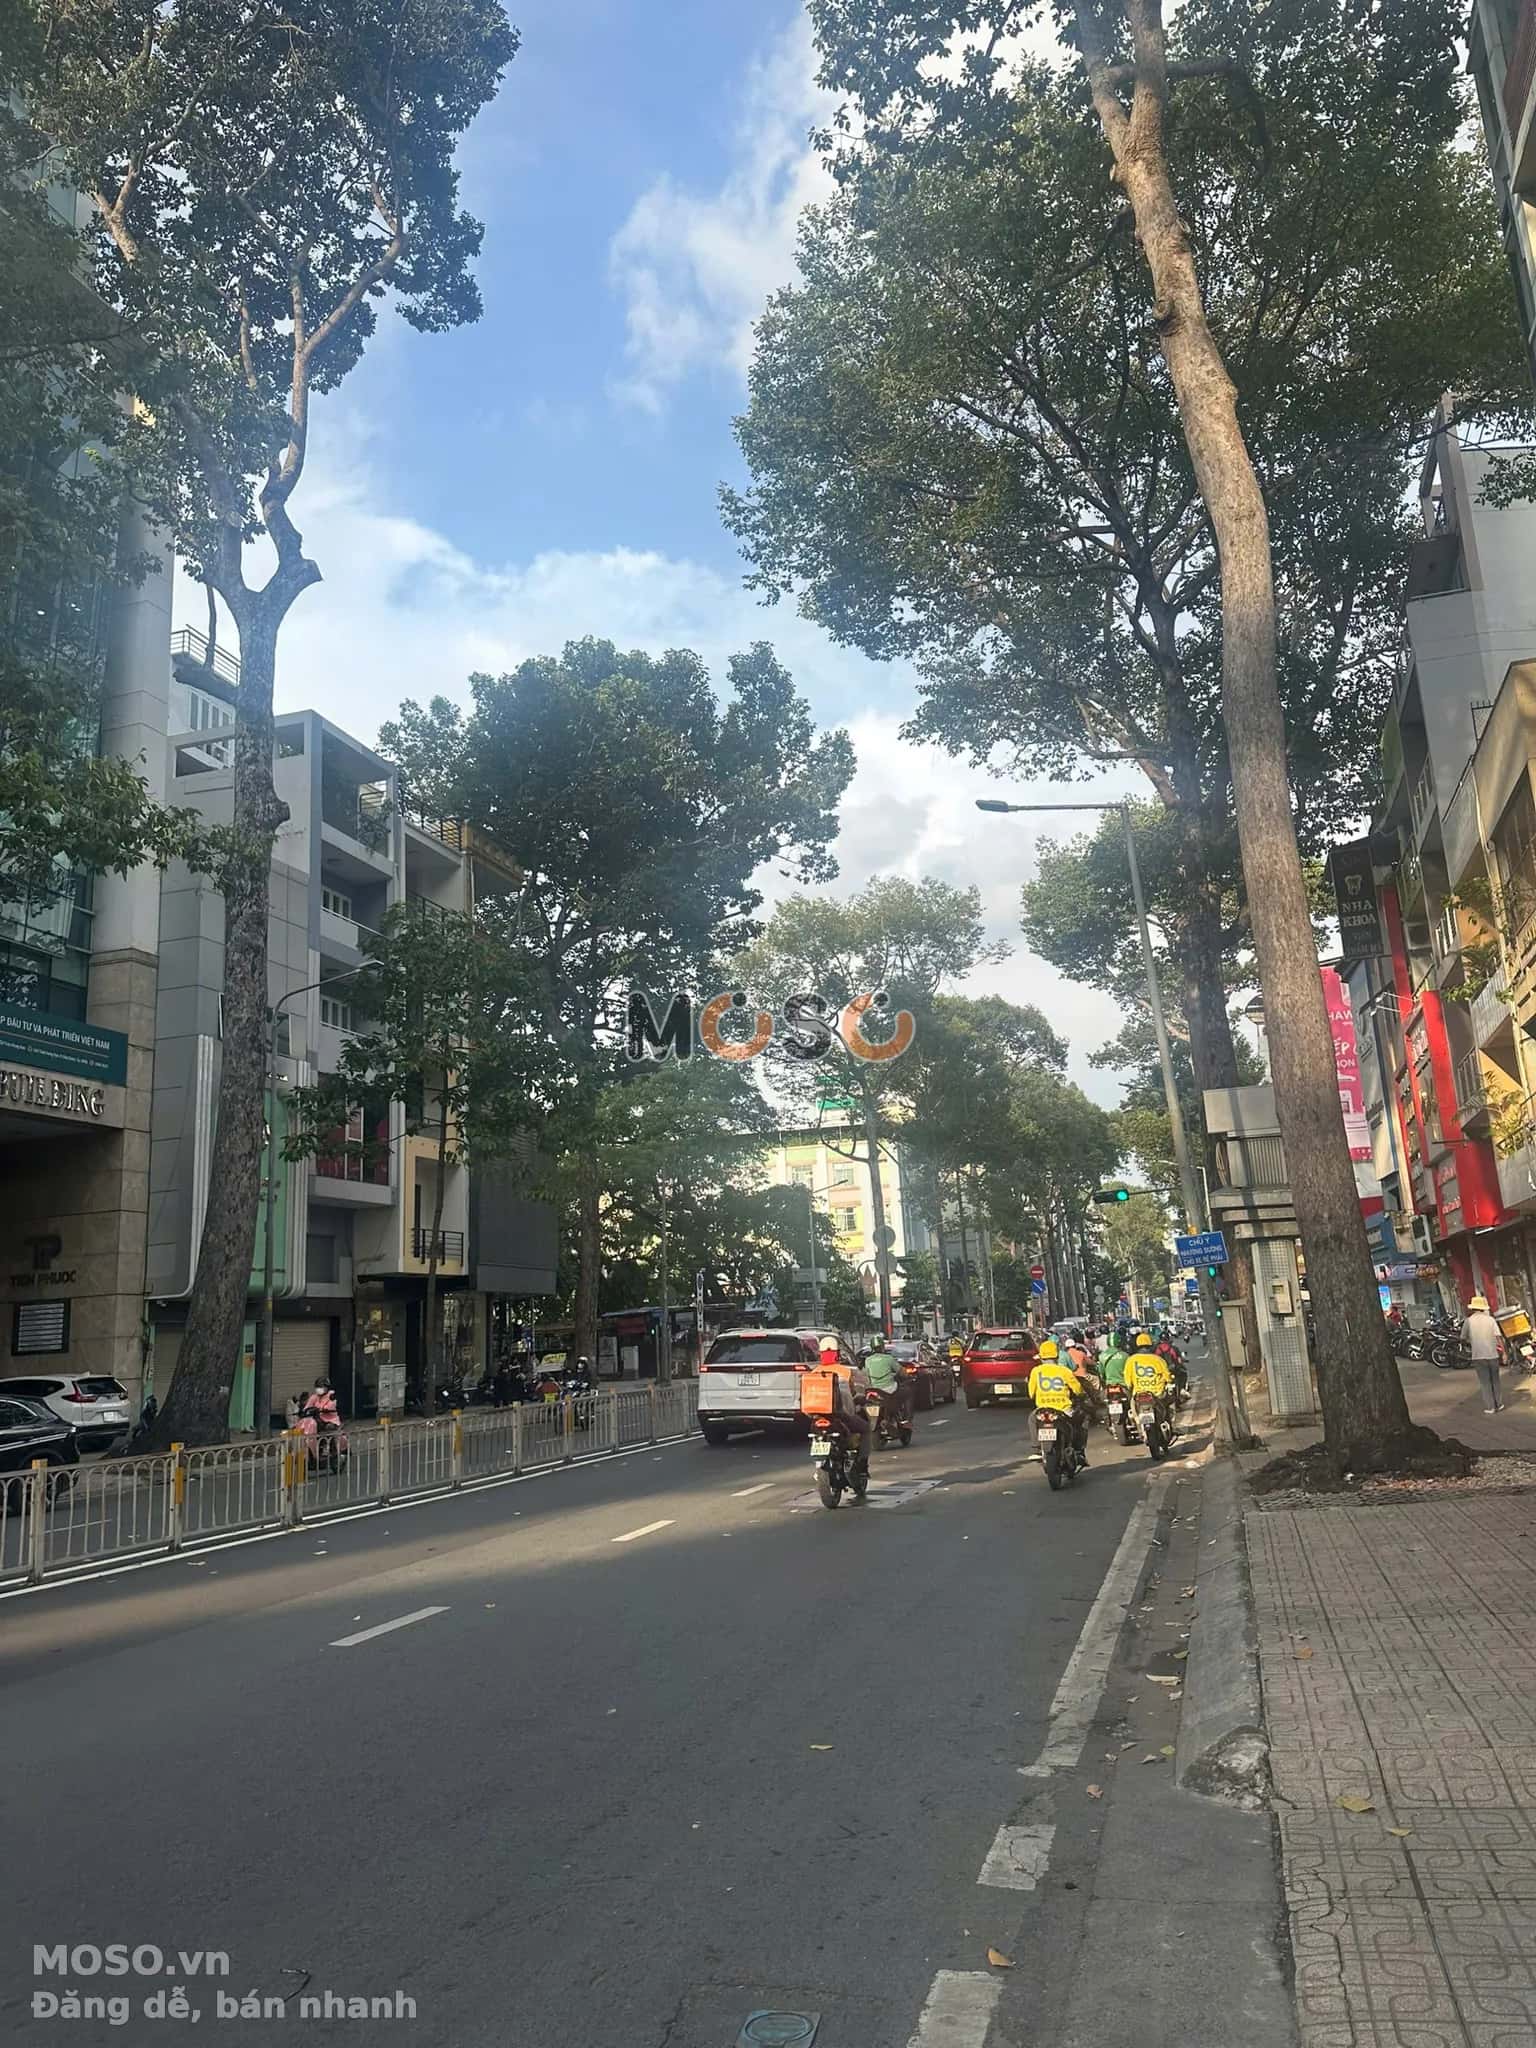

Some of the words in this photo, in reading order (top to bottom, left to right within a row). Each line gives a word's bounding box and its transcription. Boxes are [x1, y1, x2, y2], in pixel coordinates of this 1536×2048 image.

[1342, 900, 1373, 912] NHA
[1344, 913, 1377, 927] KHOA
[1135, 1361, 1156, 1377] be
[1039, 1372, 1064, 1391] be
